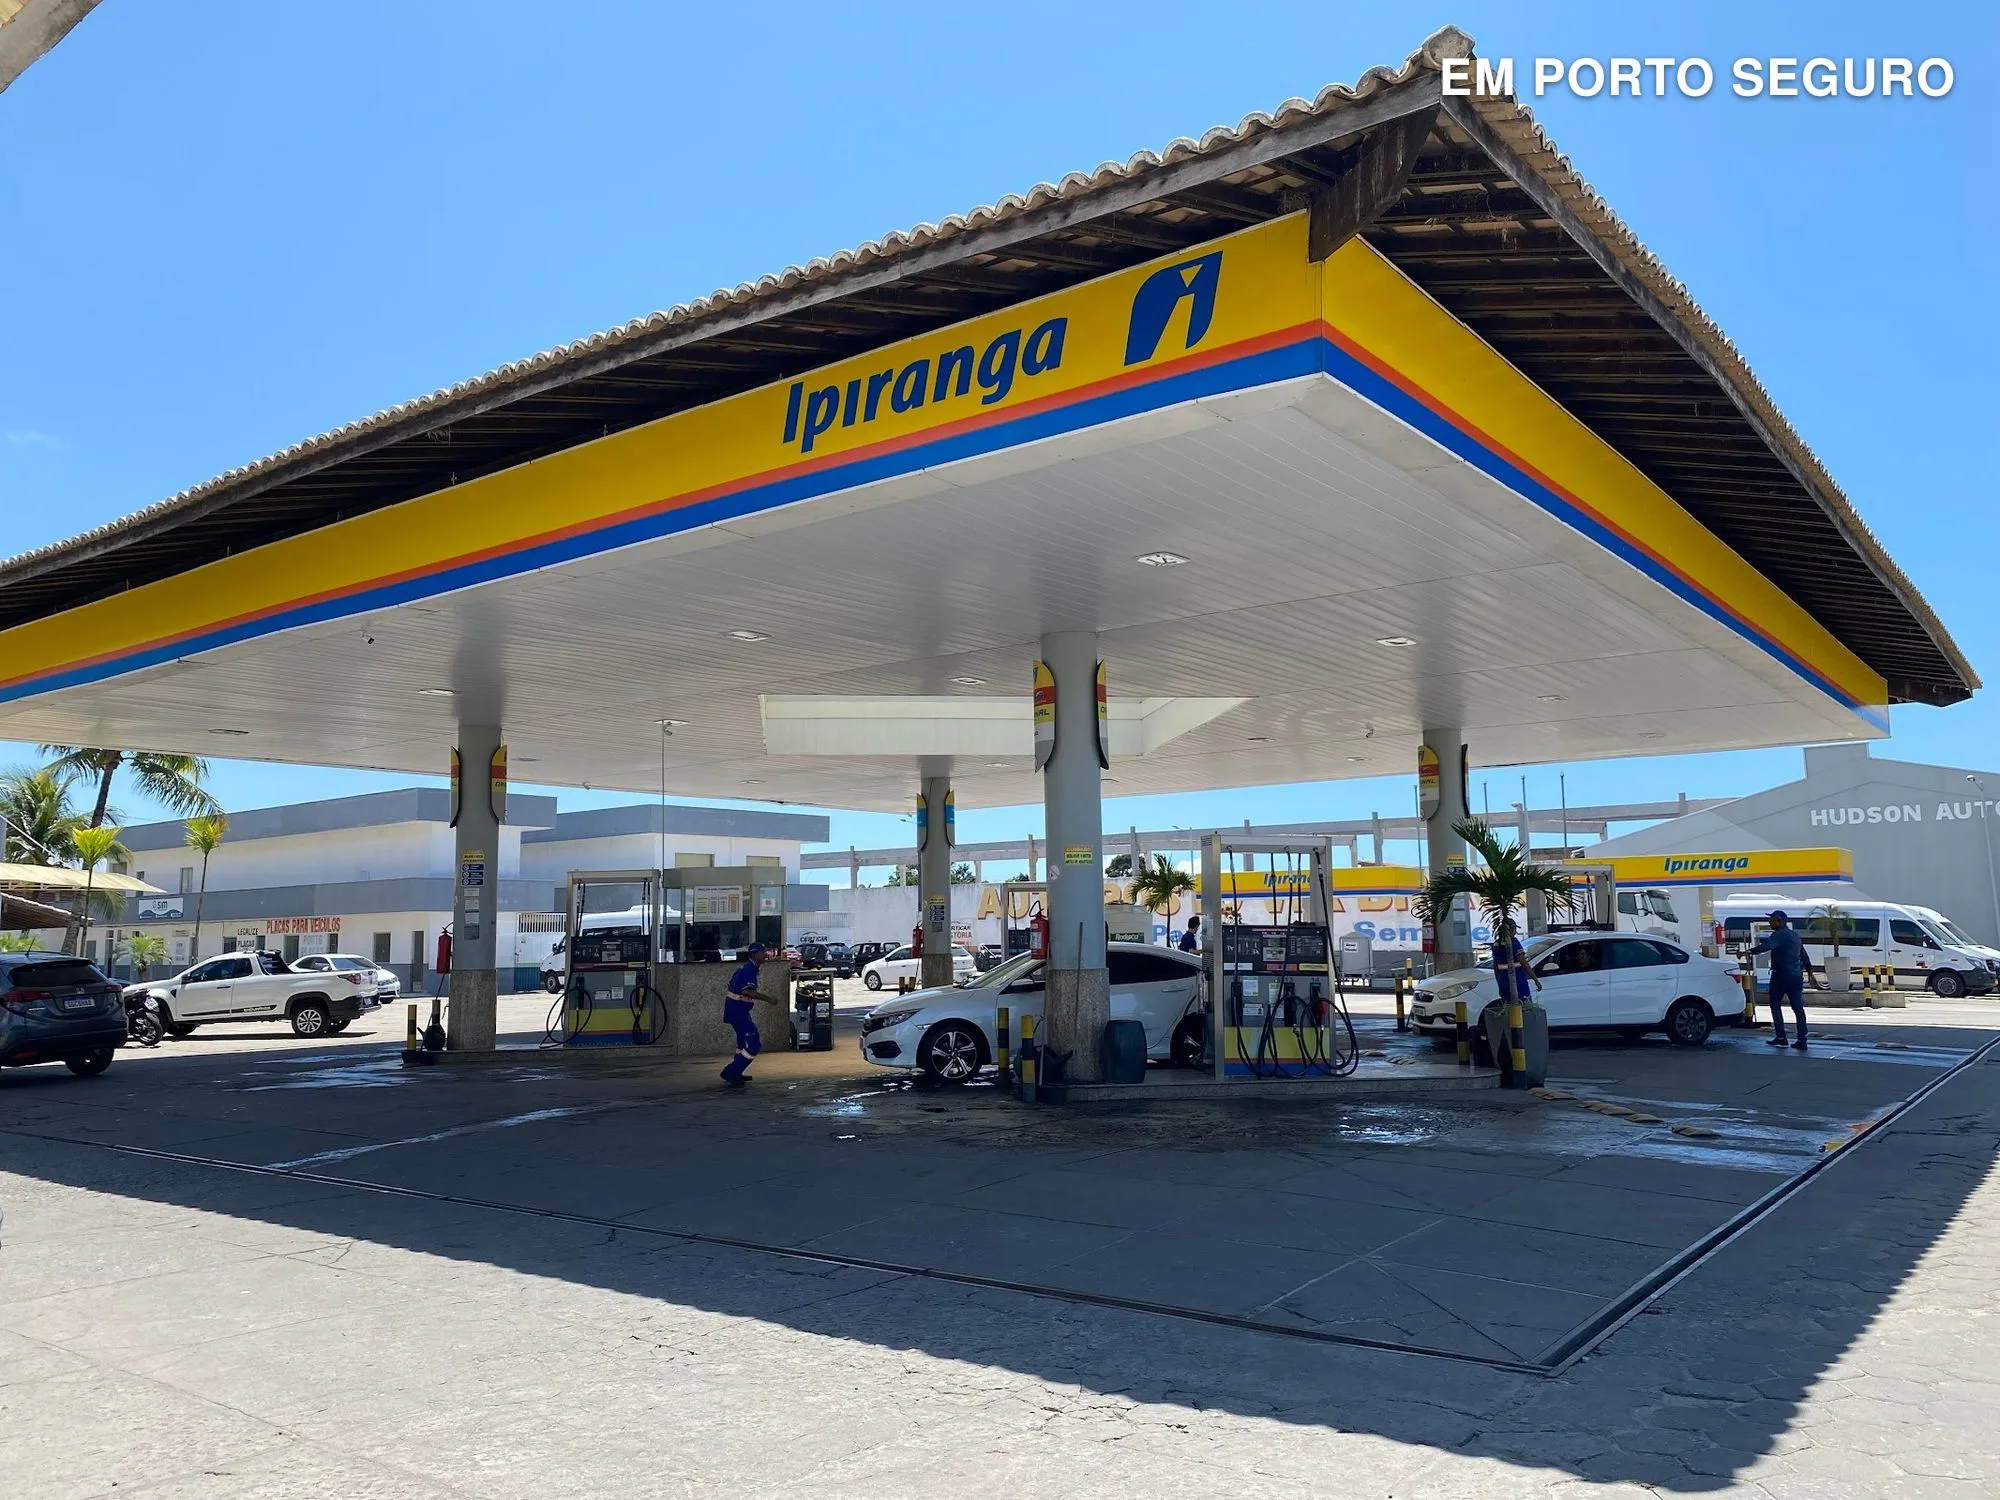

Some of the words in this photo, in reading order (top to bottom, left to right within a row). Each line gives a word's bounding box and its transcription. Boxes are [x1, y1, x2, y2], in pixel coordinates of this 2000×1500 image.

[783, 317, 1068, 453] Ipiranga
[1811, 804, 1922, 826] HUDSON
[1664, 857, 1749, 874] Ipiranga
[266, 919, 290, 935] PLACAS
[292, 918, 309, 934] PARA
